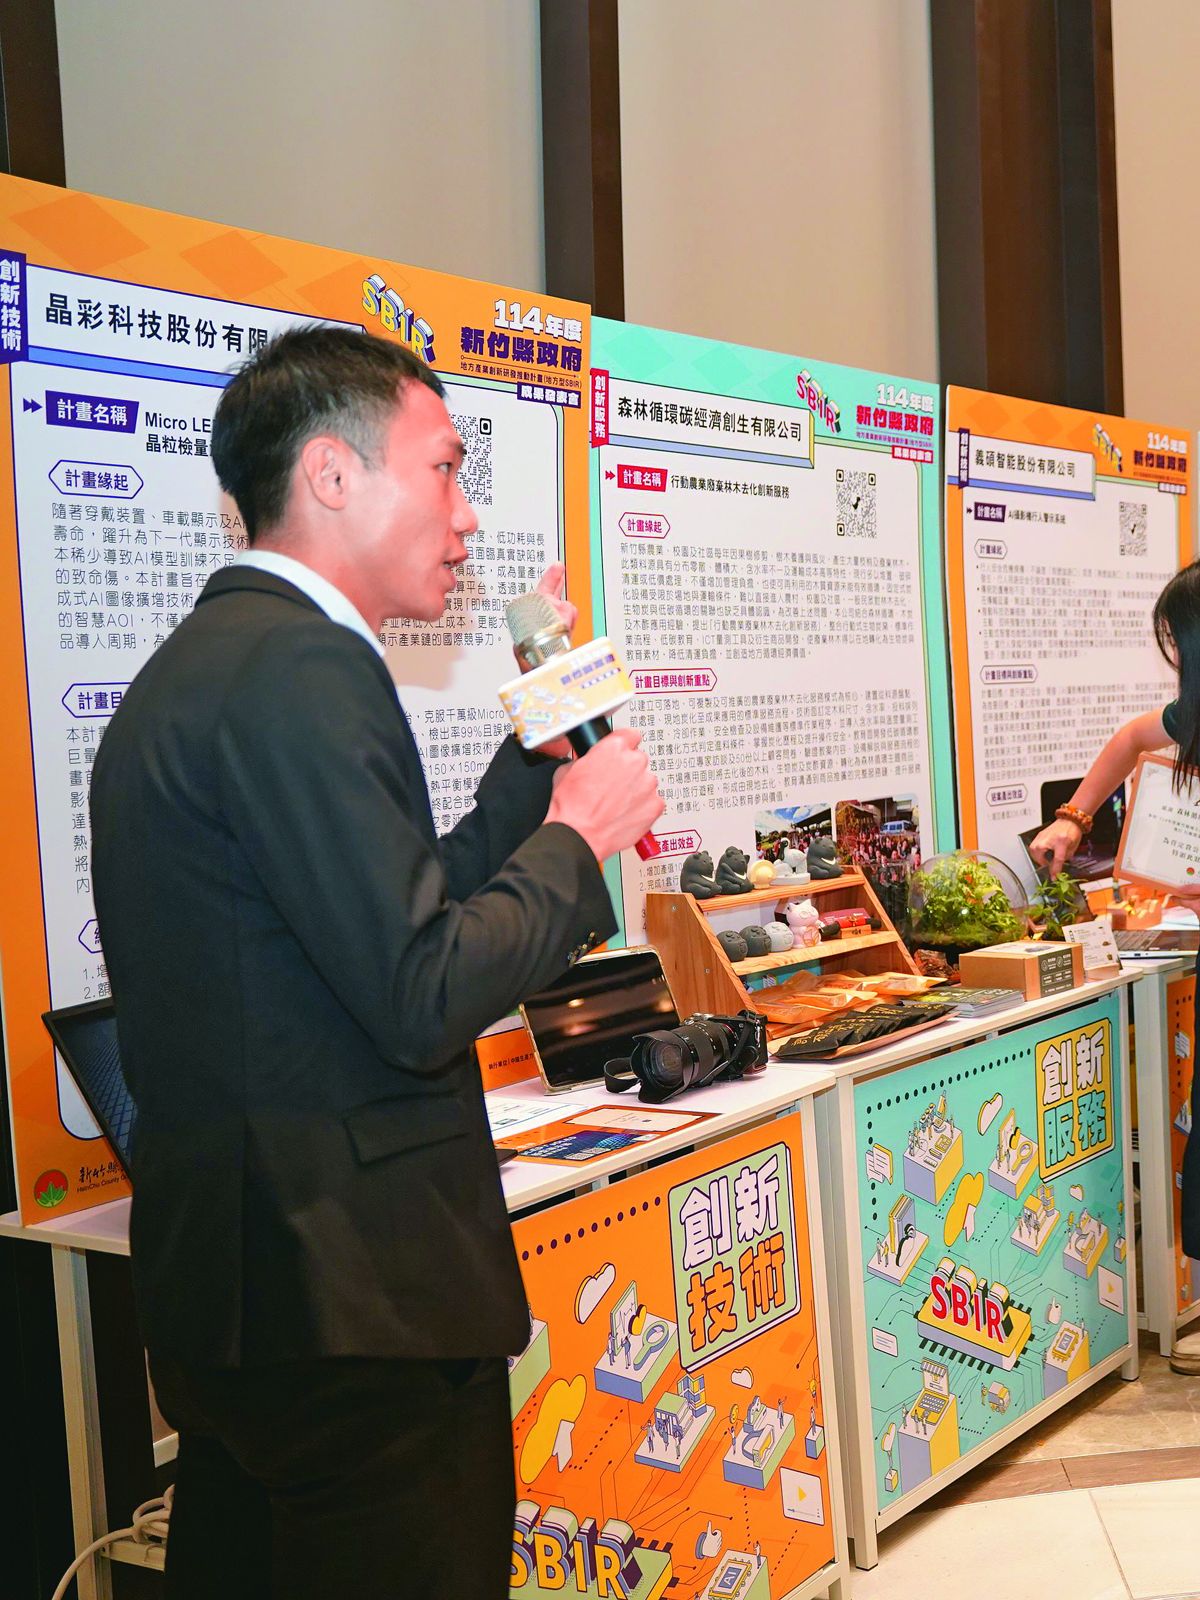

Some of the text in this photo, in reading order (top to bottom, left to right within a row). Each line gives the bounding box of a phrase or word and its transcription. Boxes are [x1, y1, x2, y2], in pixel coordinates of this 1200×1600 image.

[0, 258, 22, 352] 創新技術
[46, 292, 269, 354] 晶彩科技股份有限
[361, 273, 436, 364] SBIR
[494, 298, 583, 343] 114年度
[460, 326, 583, 372] 新竹縣政府
[57, 398, 128, 427] 計畫名稱
[520, 385, 580, 407] 成果發表會
[796, 369, 841, 434] SBIR
[877, 383, 934, 414] 114年度
[145, 411, 188, 431] Micro
[617, 396, 803, 443] 森林循環碳經濟創生有限公司
[856, 405, 934, 436] 新竹縣政府
[146, 433, 212, 458] 晶粒檢量
[65, 469, 129, 491] 計畫緣起
[623, 469, 662, 488] 計畫名稱
[627, 518, 663, 533] 計畫緣起
[634, 674, 711, 689] 計畫目標與創新重點
[1041, 1026, 1105, 1108] 創新
[1043, 1089, 1109, 1168] 服務
[679, 1153, 780, 1272] 創新
[686, 1231, 787, 1353] 技術
[929, 1259, 1013, 1344] SBIR
[722, 1570, 738, 1586] AI
